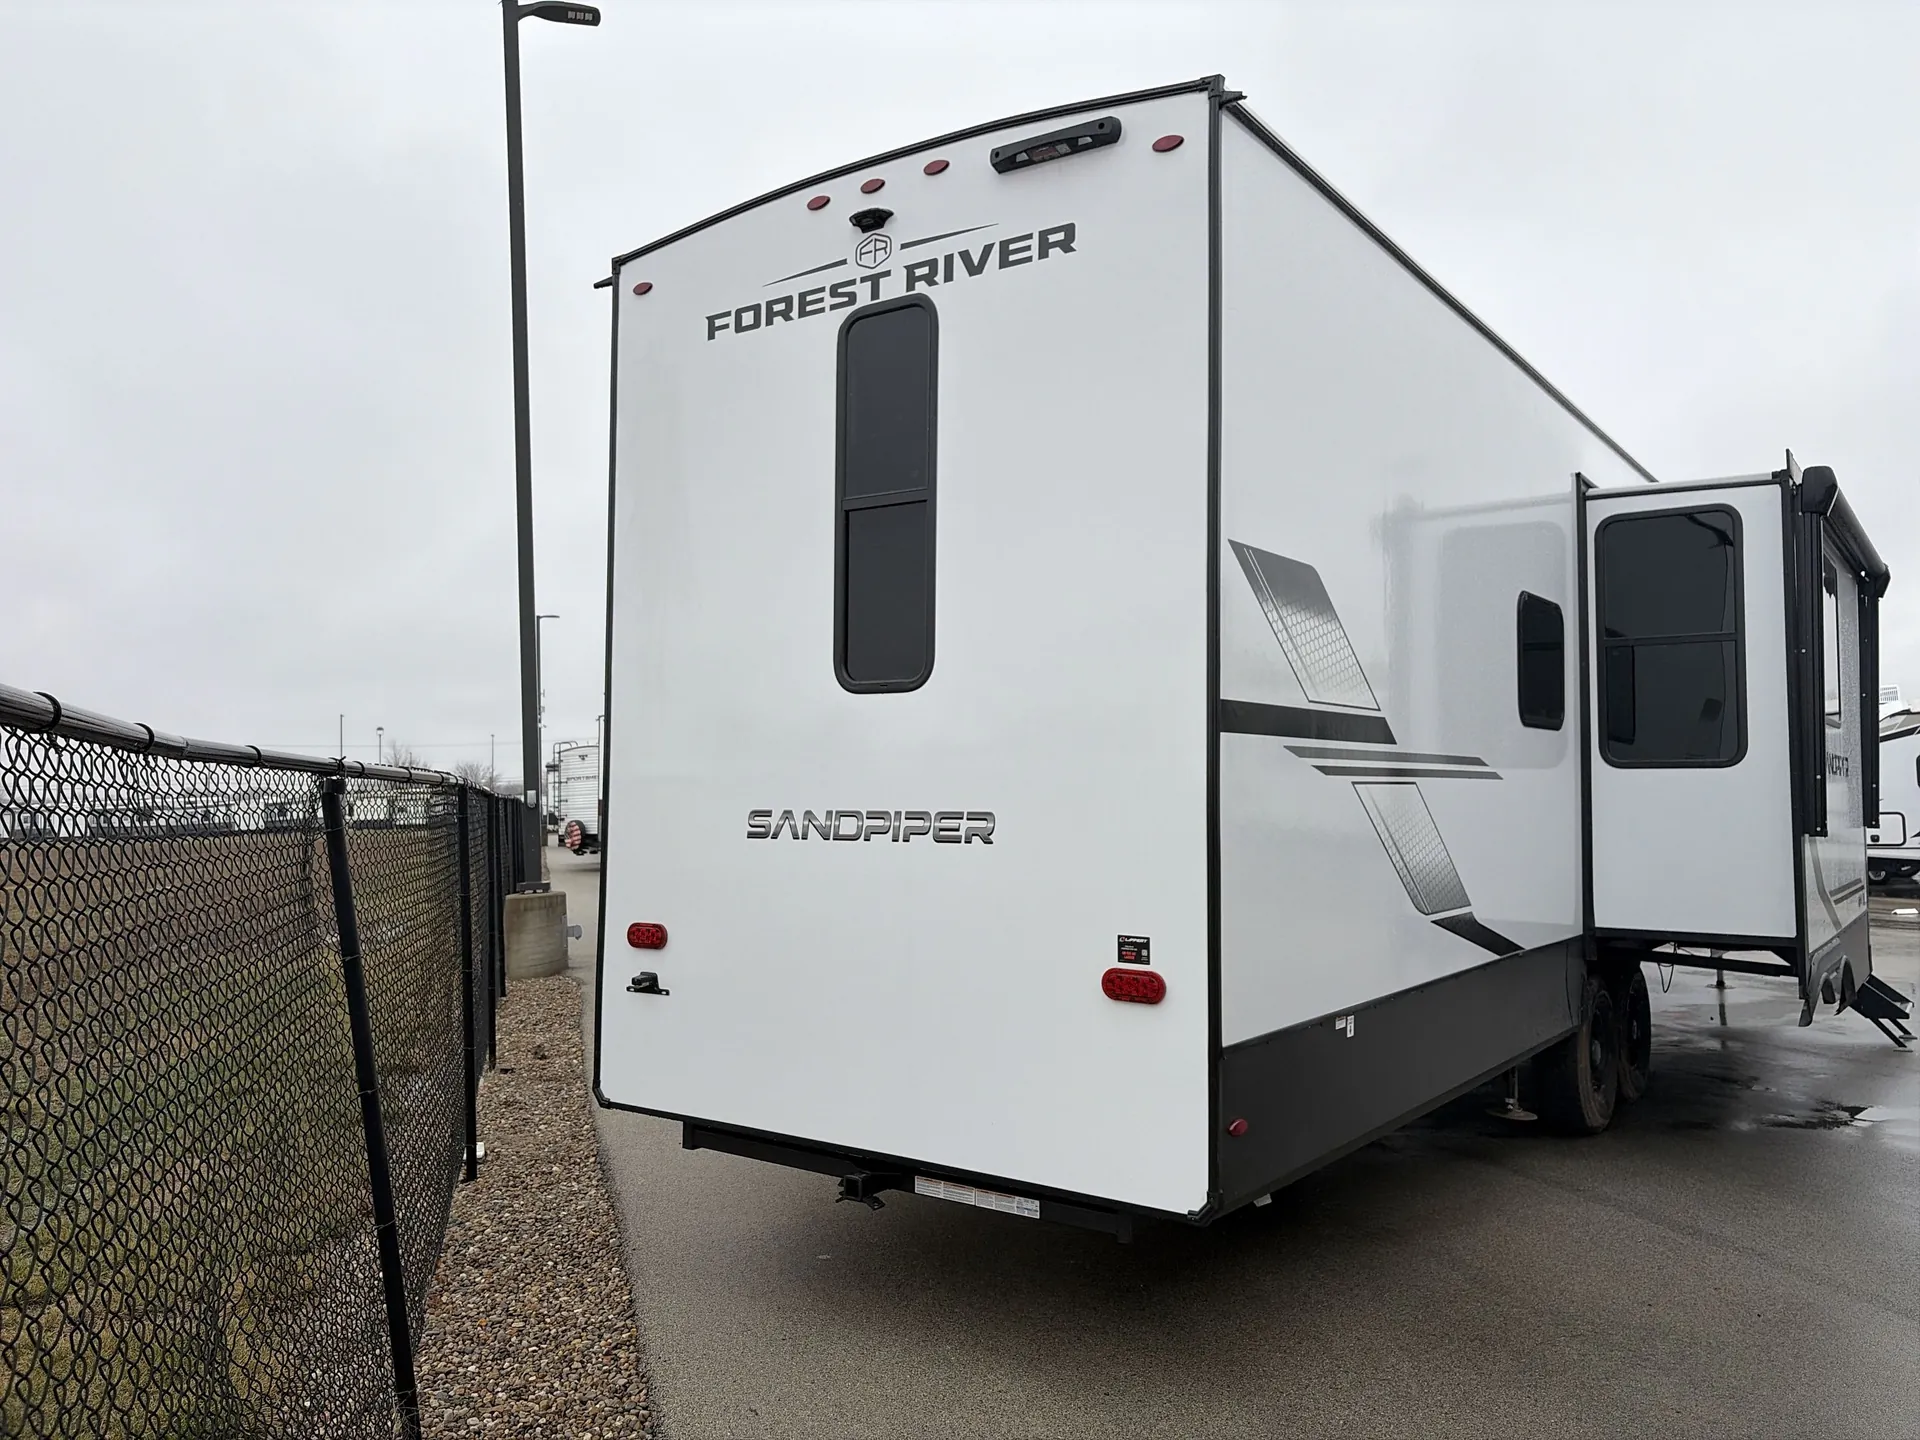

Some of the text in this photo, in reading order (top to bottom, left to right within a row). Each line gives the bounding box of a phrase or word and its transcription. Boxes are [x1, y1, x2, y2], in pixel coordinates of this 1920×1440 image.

[705, 222, 1077, 341] FOREST RIVER
[746, 809, 996, 844] SANDPIPER
